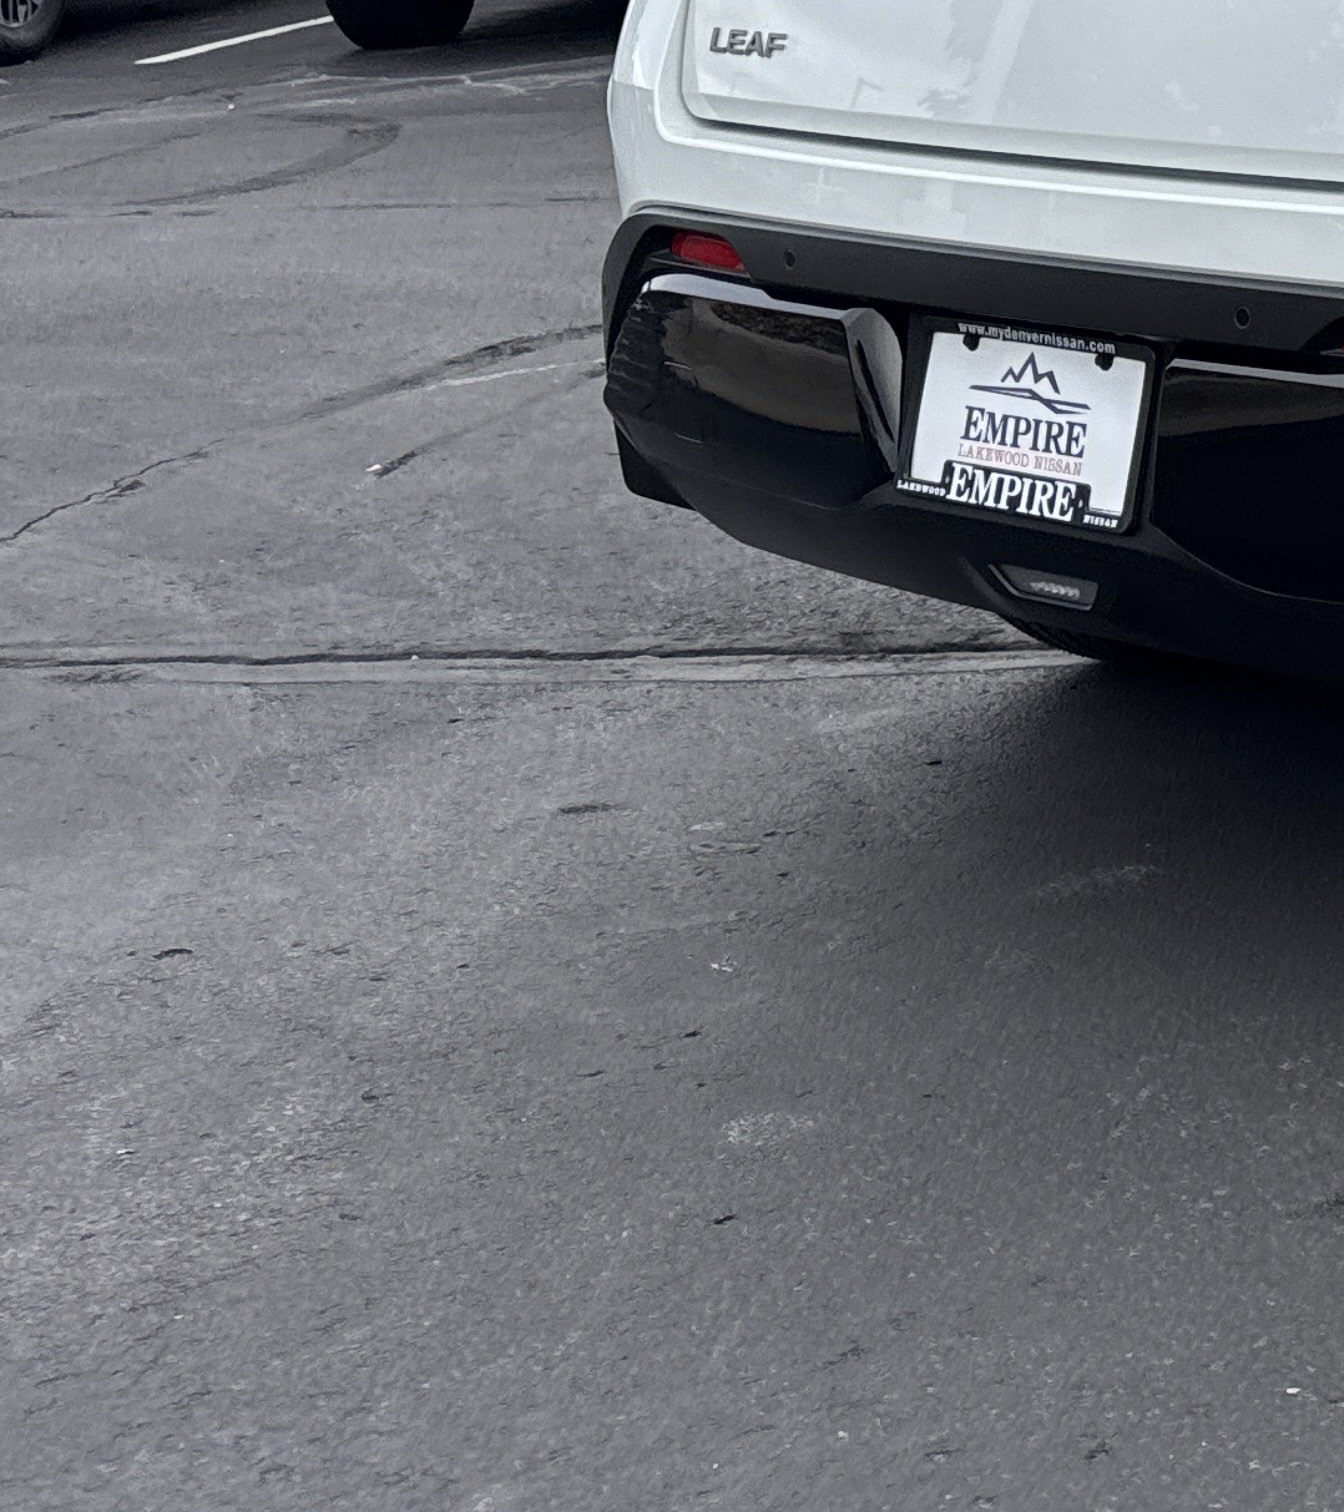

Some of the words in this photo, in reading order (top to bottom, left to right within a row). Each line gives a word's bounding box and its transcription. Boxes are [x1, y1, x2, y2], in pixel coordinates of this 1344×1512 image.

[709, 27, 788, 59] LEAF
[957, 322, 1116, 355] www.mydenvernissan.com
[960, 405, 1088, 458] EMPIRE
[958, 443, 1030, 467] LAKEWOOD
[1034, 455, 1083, 476] NISSAN
[946, 462, 1076, 521] EMPIRE
